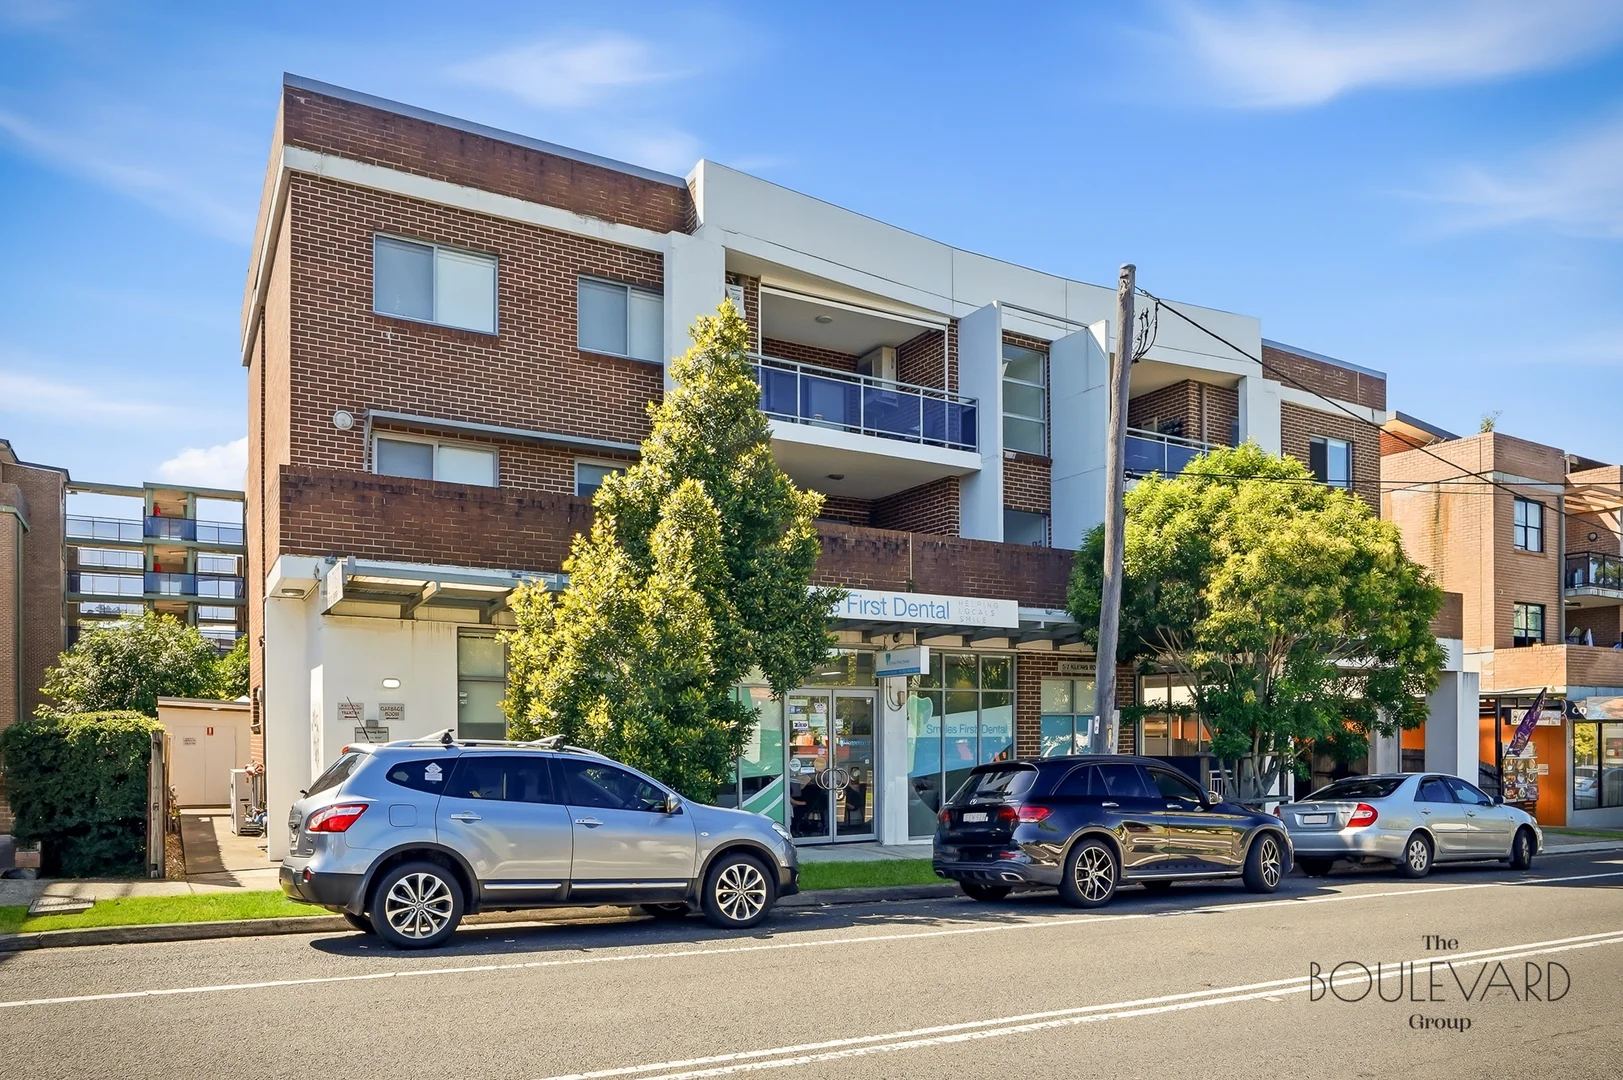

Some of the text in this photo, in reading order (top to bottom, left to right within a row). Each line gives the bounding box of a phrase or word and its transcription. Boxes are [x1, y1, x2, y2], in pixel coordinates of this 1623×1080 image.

[847, 593, 950, 620] First Dental
[958, 599, 999, 610] HELPING
[958, 607, 996, 617] LOCALS
[959, 615, 987, 624] SMILE
[926, 723, 957, 735] Smles
[981, 724, 1008, 734] Dental
